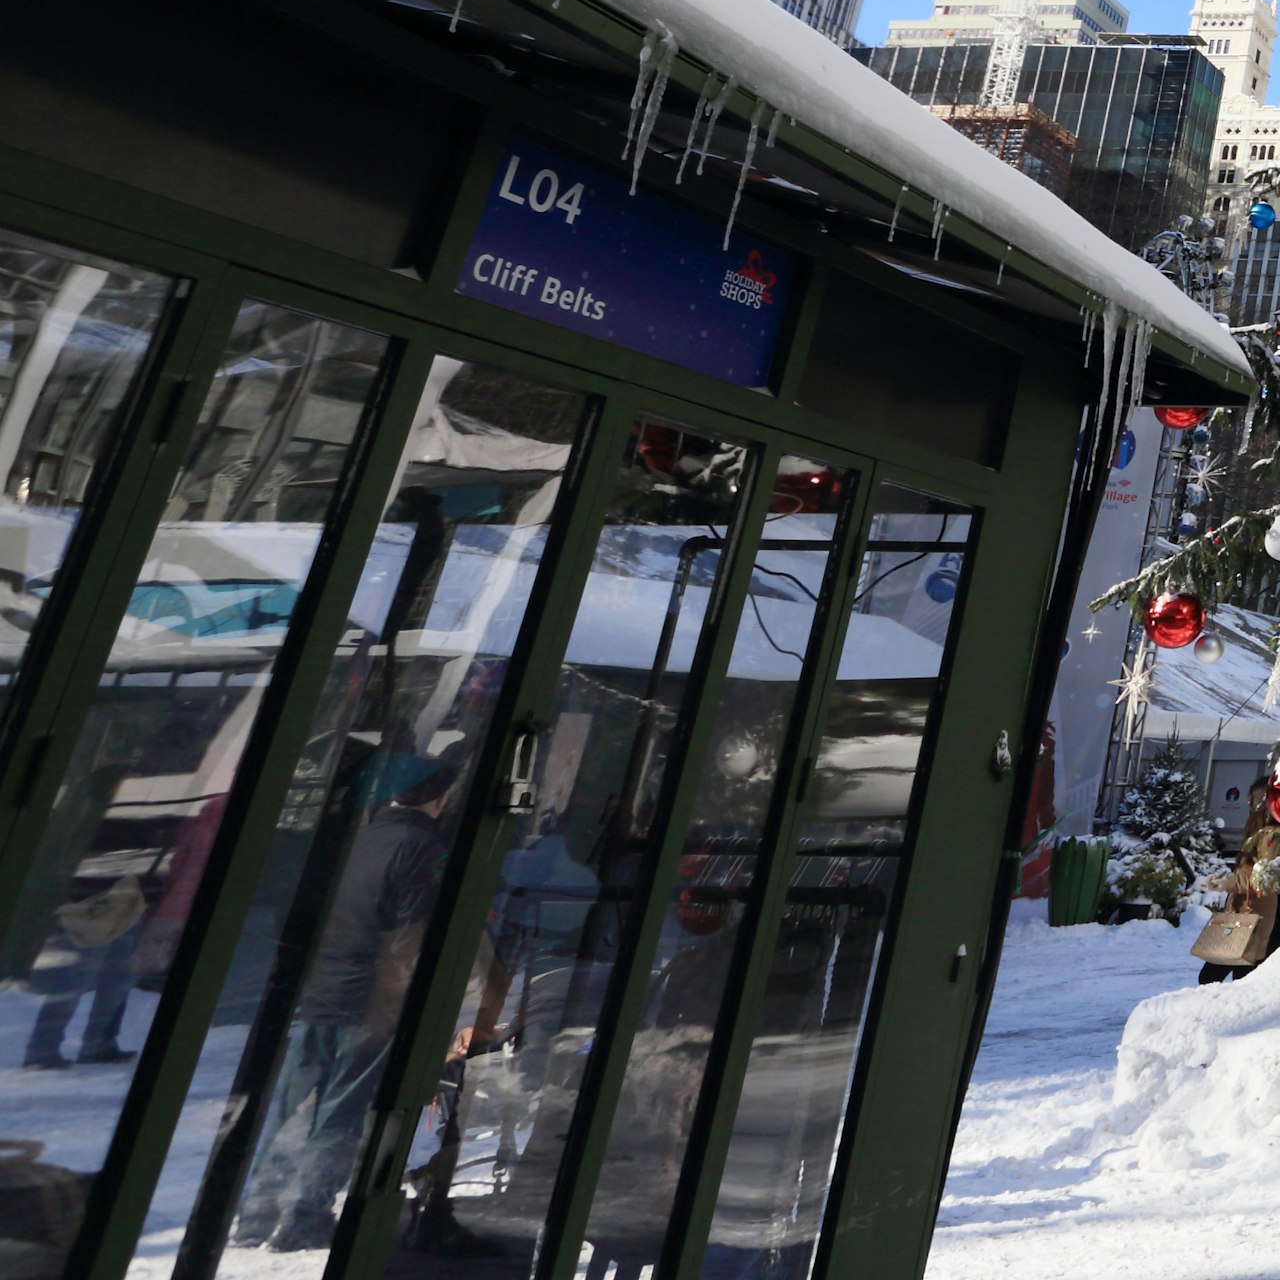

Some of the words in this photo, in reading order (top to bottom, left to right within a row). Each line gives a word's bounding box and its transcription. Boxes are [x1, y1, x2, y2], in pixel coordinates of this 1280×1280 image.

[498, 155, 584, 225] L04
[472, 252, 540, 296] Cliff
[540, 276, 607, 321] Belts
[725, 269, 767, 294] HOLIDAY
[720, 283, 764, 310] SHOPS
[1105, 490, 1137, 504] illage
